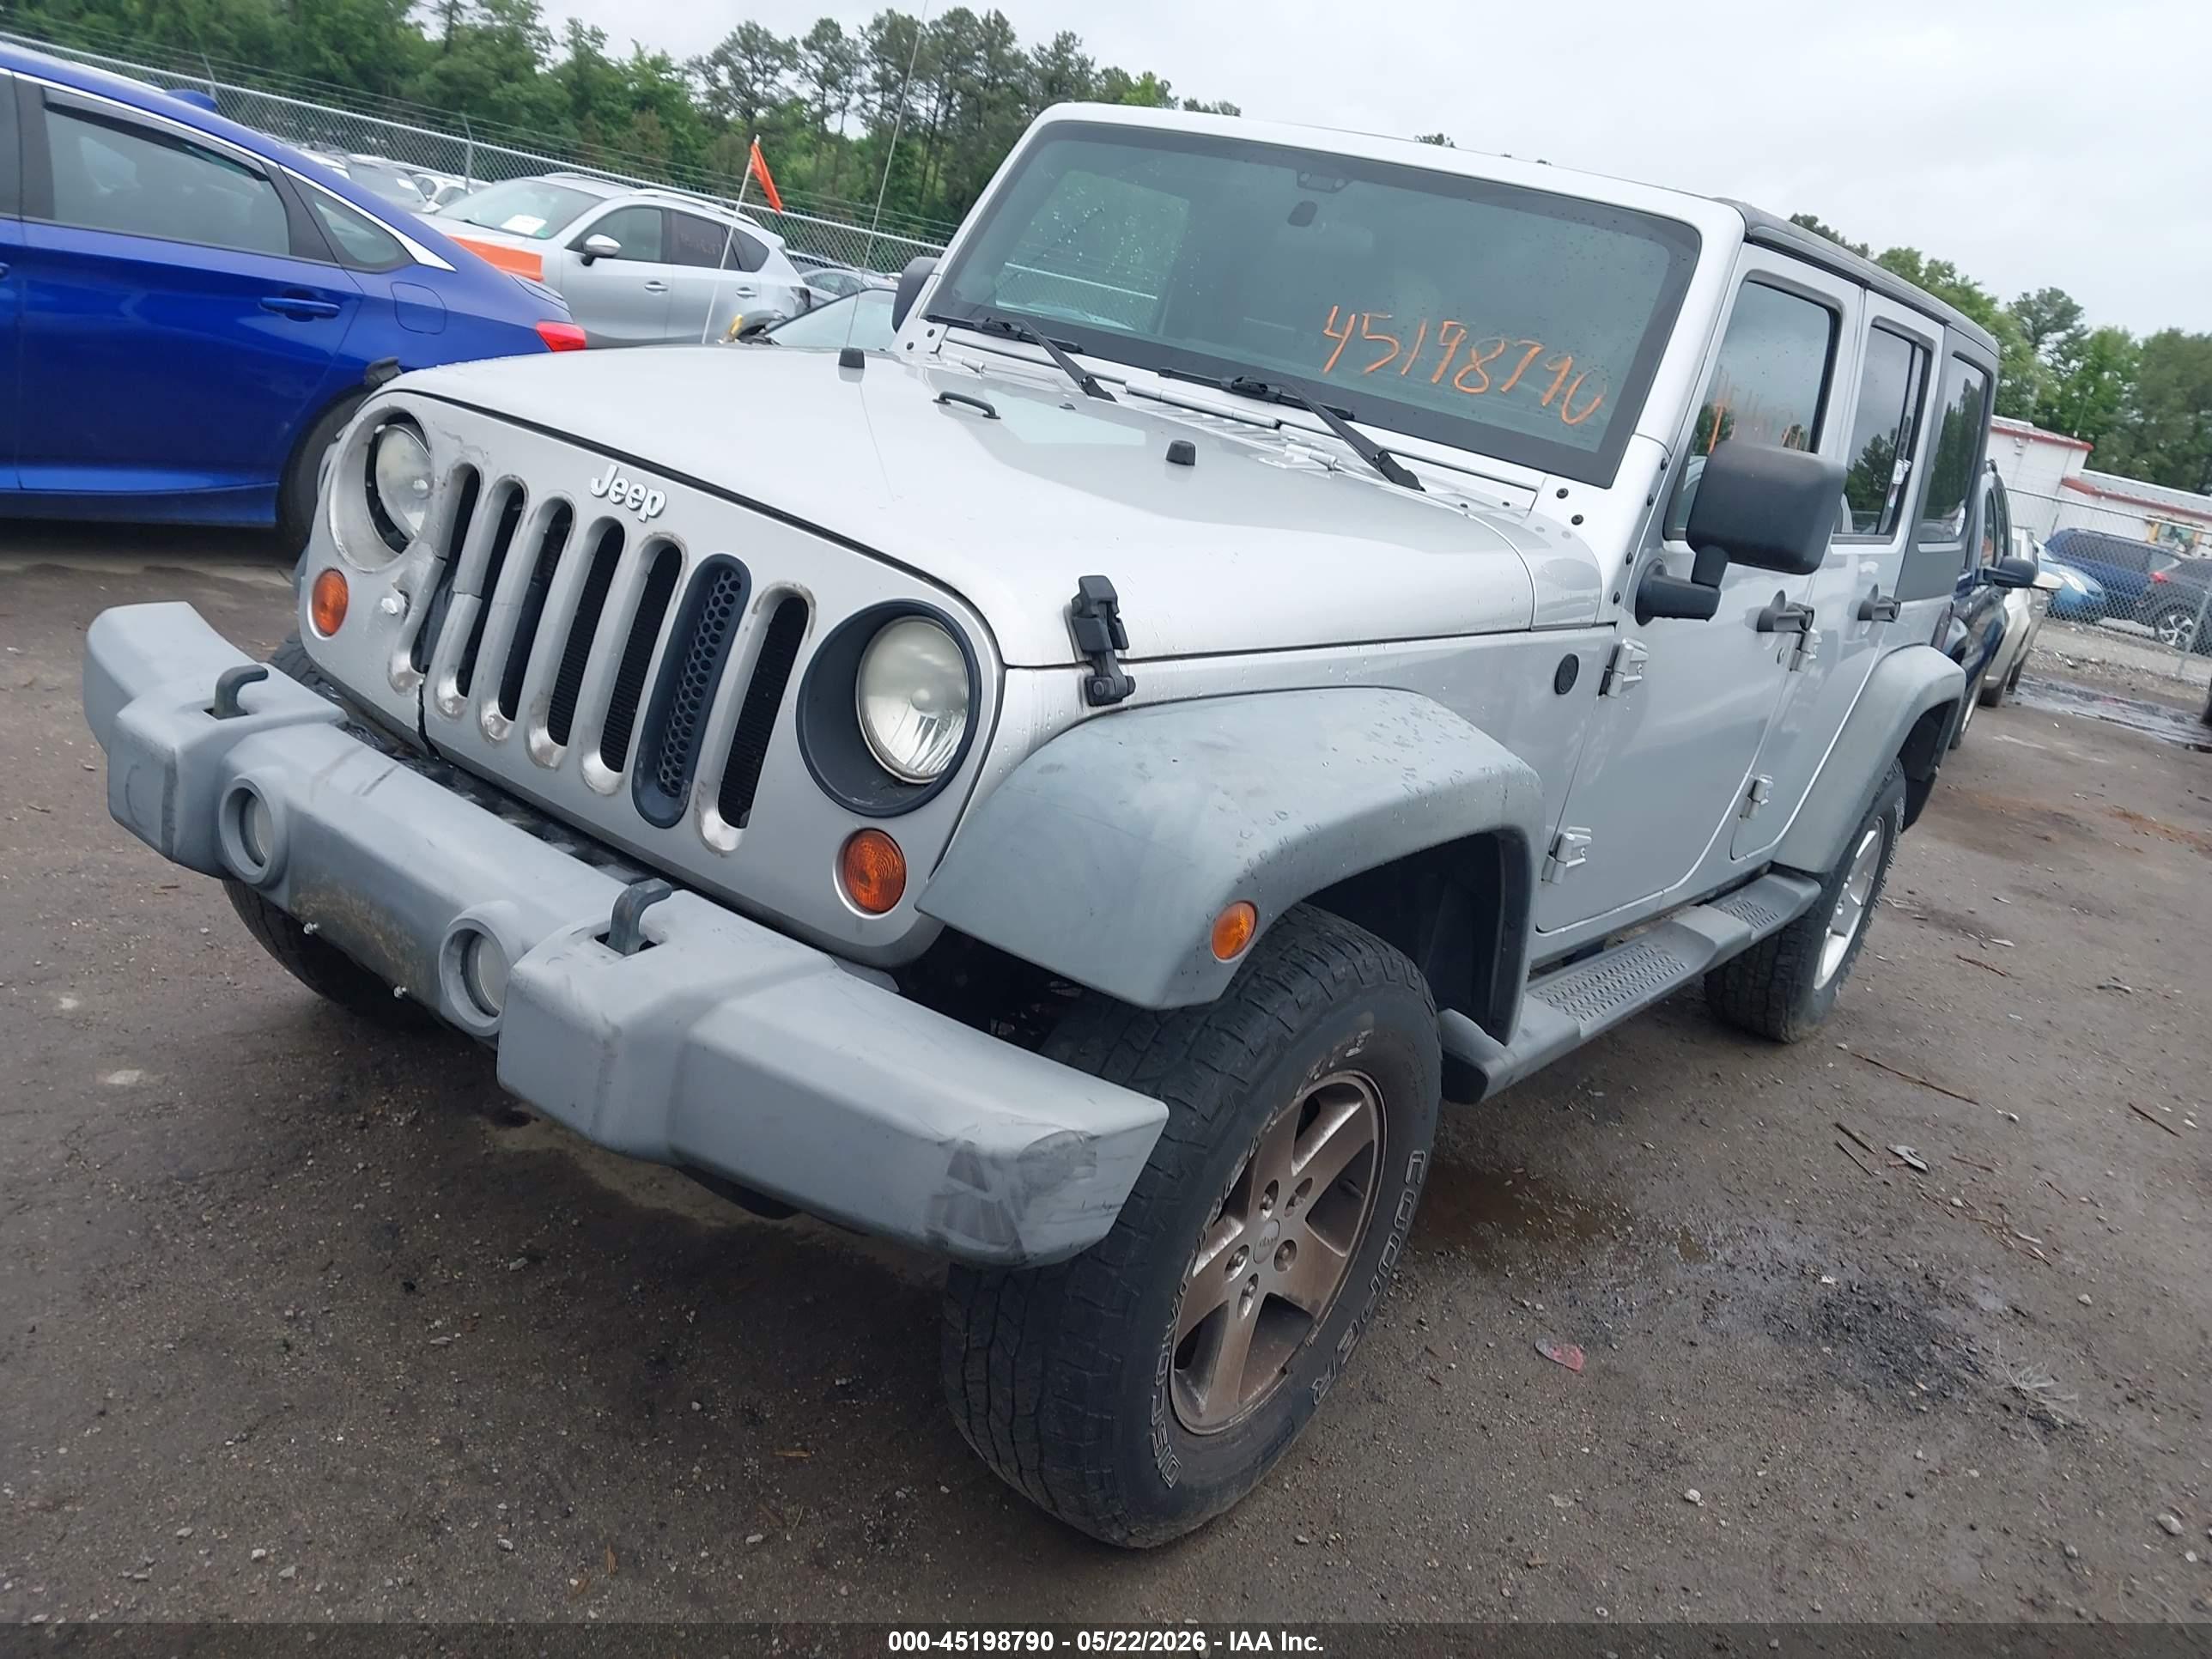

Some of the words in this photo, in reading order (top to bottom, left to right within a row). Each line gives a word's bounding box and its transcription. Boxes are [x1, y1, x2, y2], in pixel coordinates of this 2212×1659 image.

[1322, 304, 1609, 426] 45198790
[590, 464, 666, 523] Jeep
[1311, 1150, 1426, 1406] COOPER
